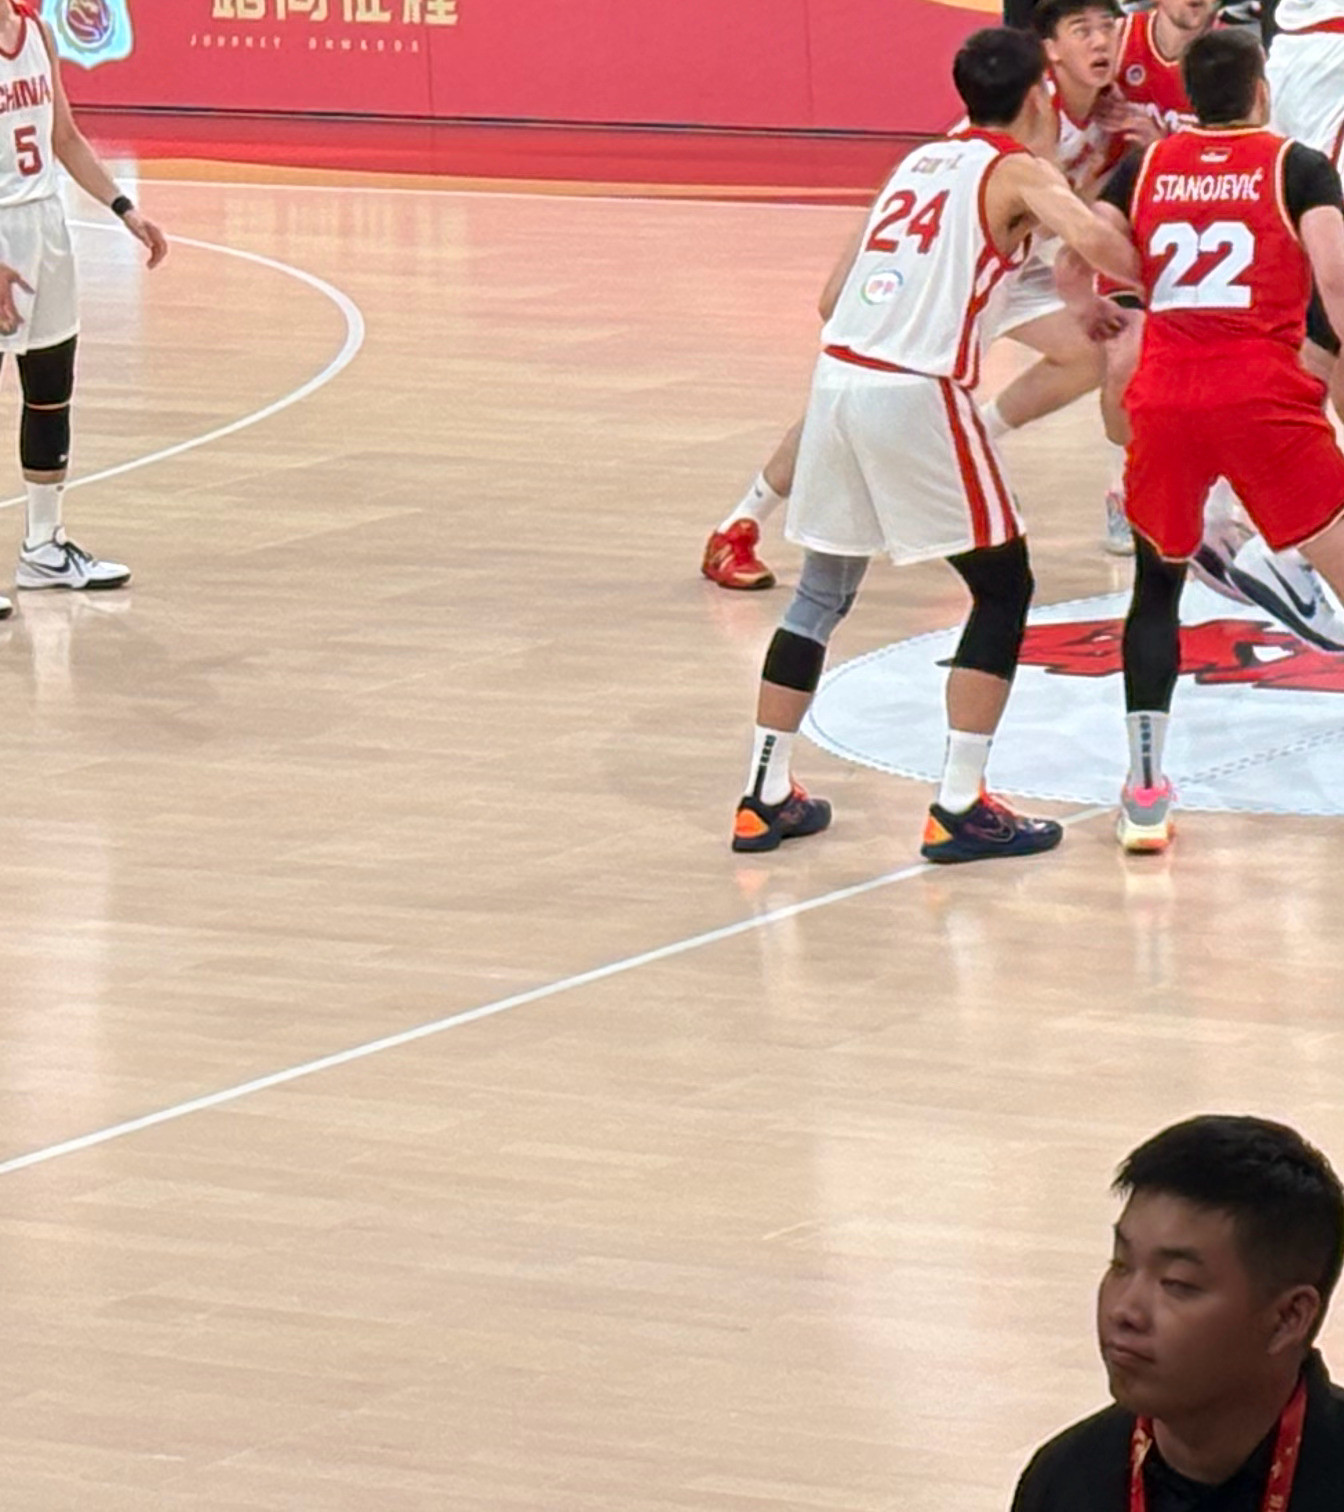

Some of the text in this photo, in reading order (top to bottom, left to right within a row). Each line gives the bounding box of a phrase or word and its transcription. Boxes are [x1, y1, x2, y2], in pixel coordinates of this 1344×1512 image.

[14, 126, 43, 178] 5
[1153, 172, 1263, 203] STANOJEVIĆ
[865, 189, 950, 255] 24
[1149, 220, 1256, 313] 22
